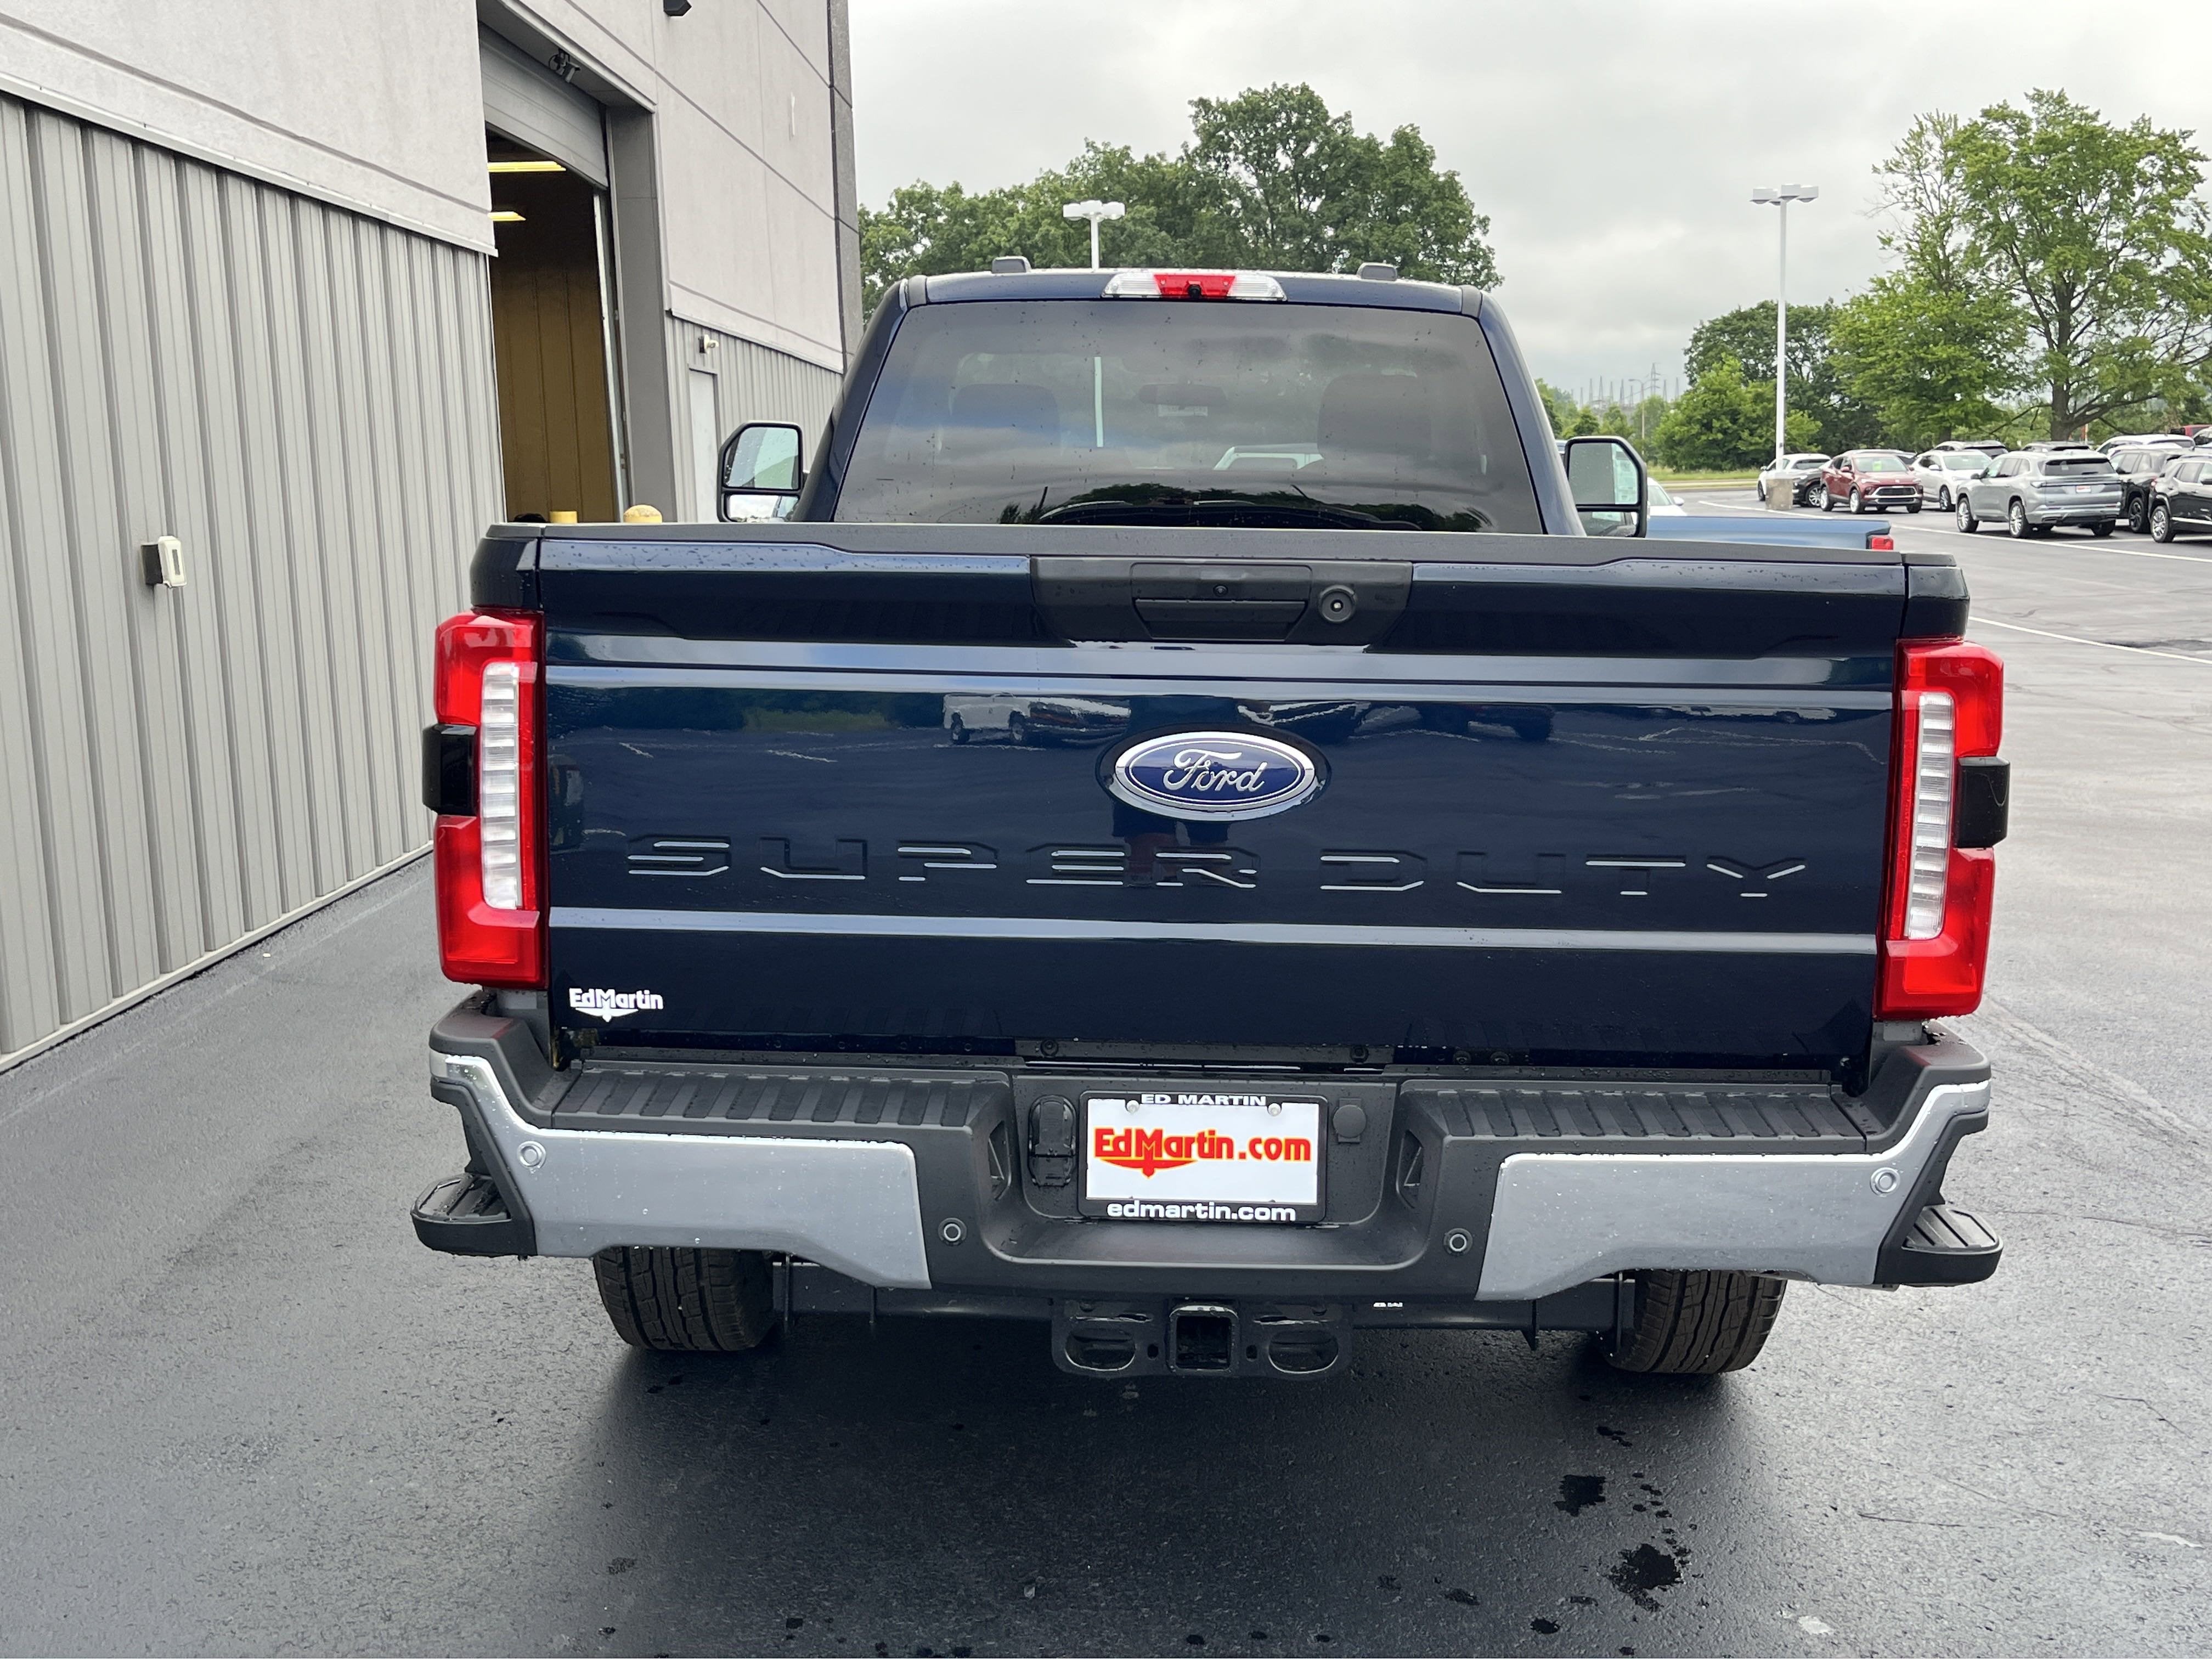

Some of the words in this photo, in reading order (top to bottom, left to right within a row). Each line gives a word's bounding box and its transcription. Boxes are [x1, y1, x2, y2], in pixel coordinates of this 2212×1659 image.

[1163, 748, 1268, 792] Ford
[628, 834, 1260, 888] SUPER
[1319, 848, 1805, 897] DUTY
[569, 988, 664, 1010] EdMartin
[1141, 1093, 1171, 1105] ED
[1178, 1094, 1266, 1107] MARTIN
[1107, 1200, 1296, 1221] edmartin.com
